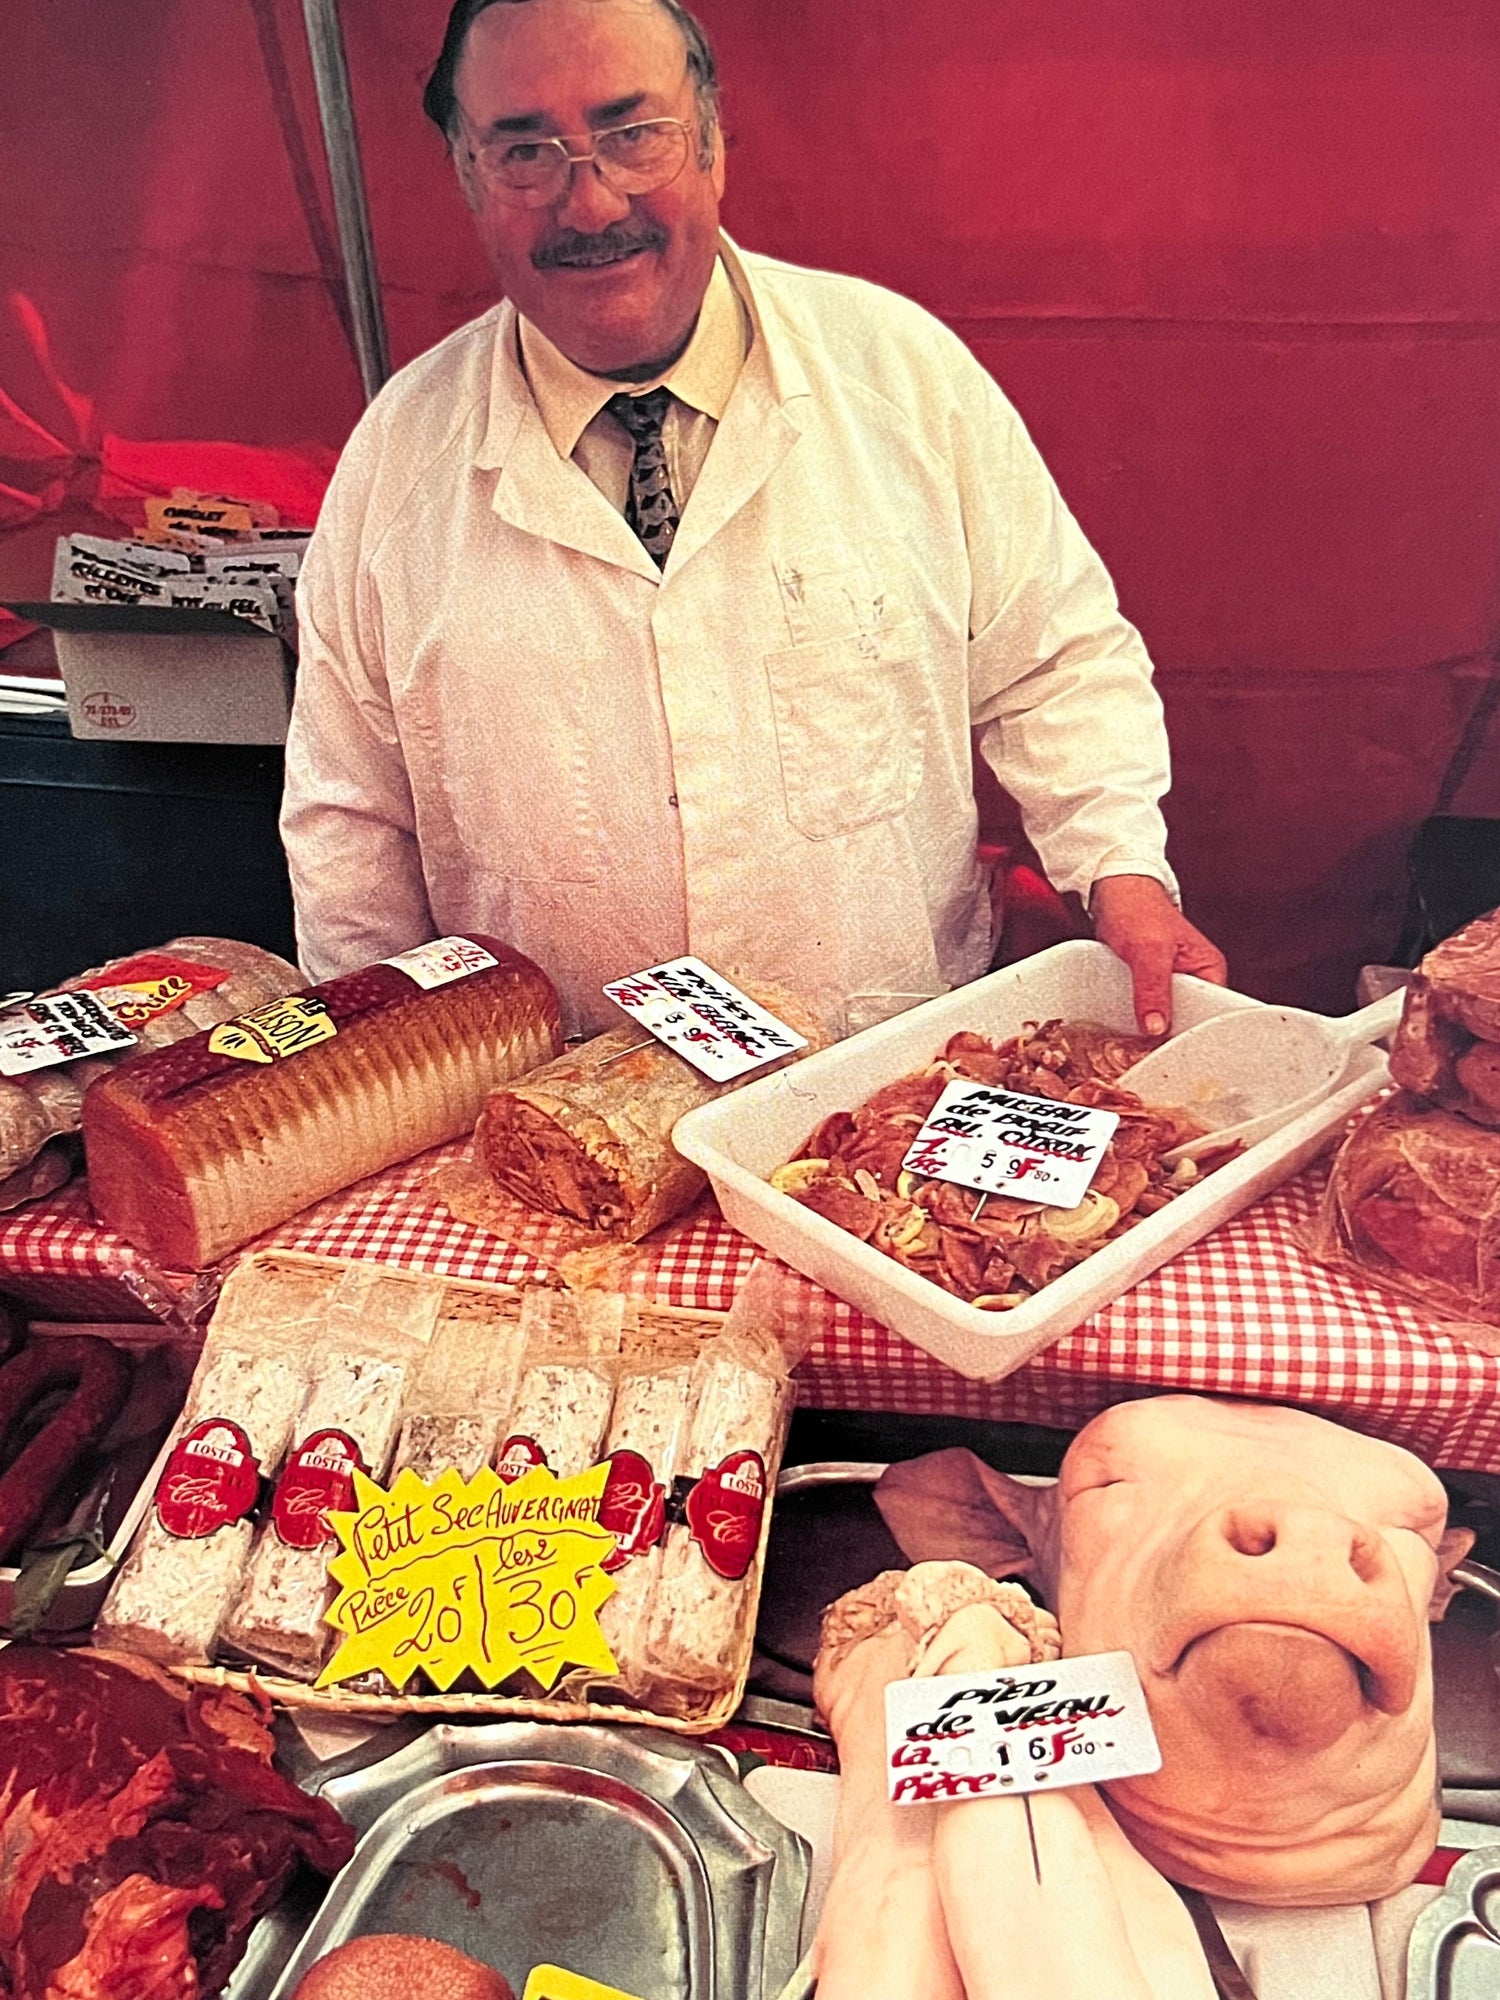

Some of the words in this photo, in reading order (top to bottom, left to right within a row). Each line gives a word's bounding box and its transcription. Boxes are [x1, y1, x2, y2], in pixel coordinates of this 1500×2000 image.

[752, 1026, 795, 1048] AU
[961, 1090, 1092, 1122] MUSEAU
[929, 1117, 984, 1134] AU
[945, 1104, 992, 1118] de
[992, 1113, 1091, 1137] BOEUF
[193, 1442, 238, 1464] LOSTE
[305, 1453, 347, 1473] LOSTE
[353, 1503, 424, 1577] Petit
[431, 1493, 485, 1535] Sec
[486, 1488, 601, 1529] AUVERGNAT
[905, 1711, 974, 1738] de
[994, 1694, 1111, 1726] VEAU
